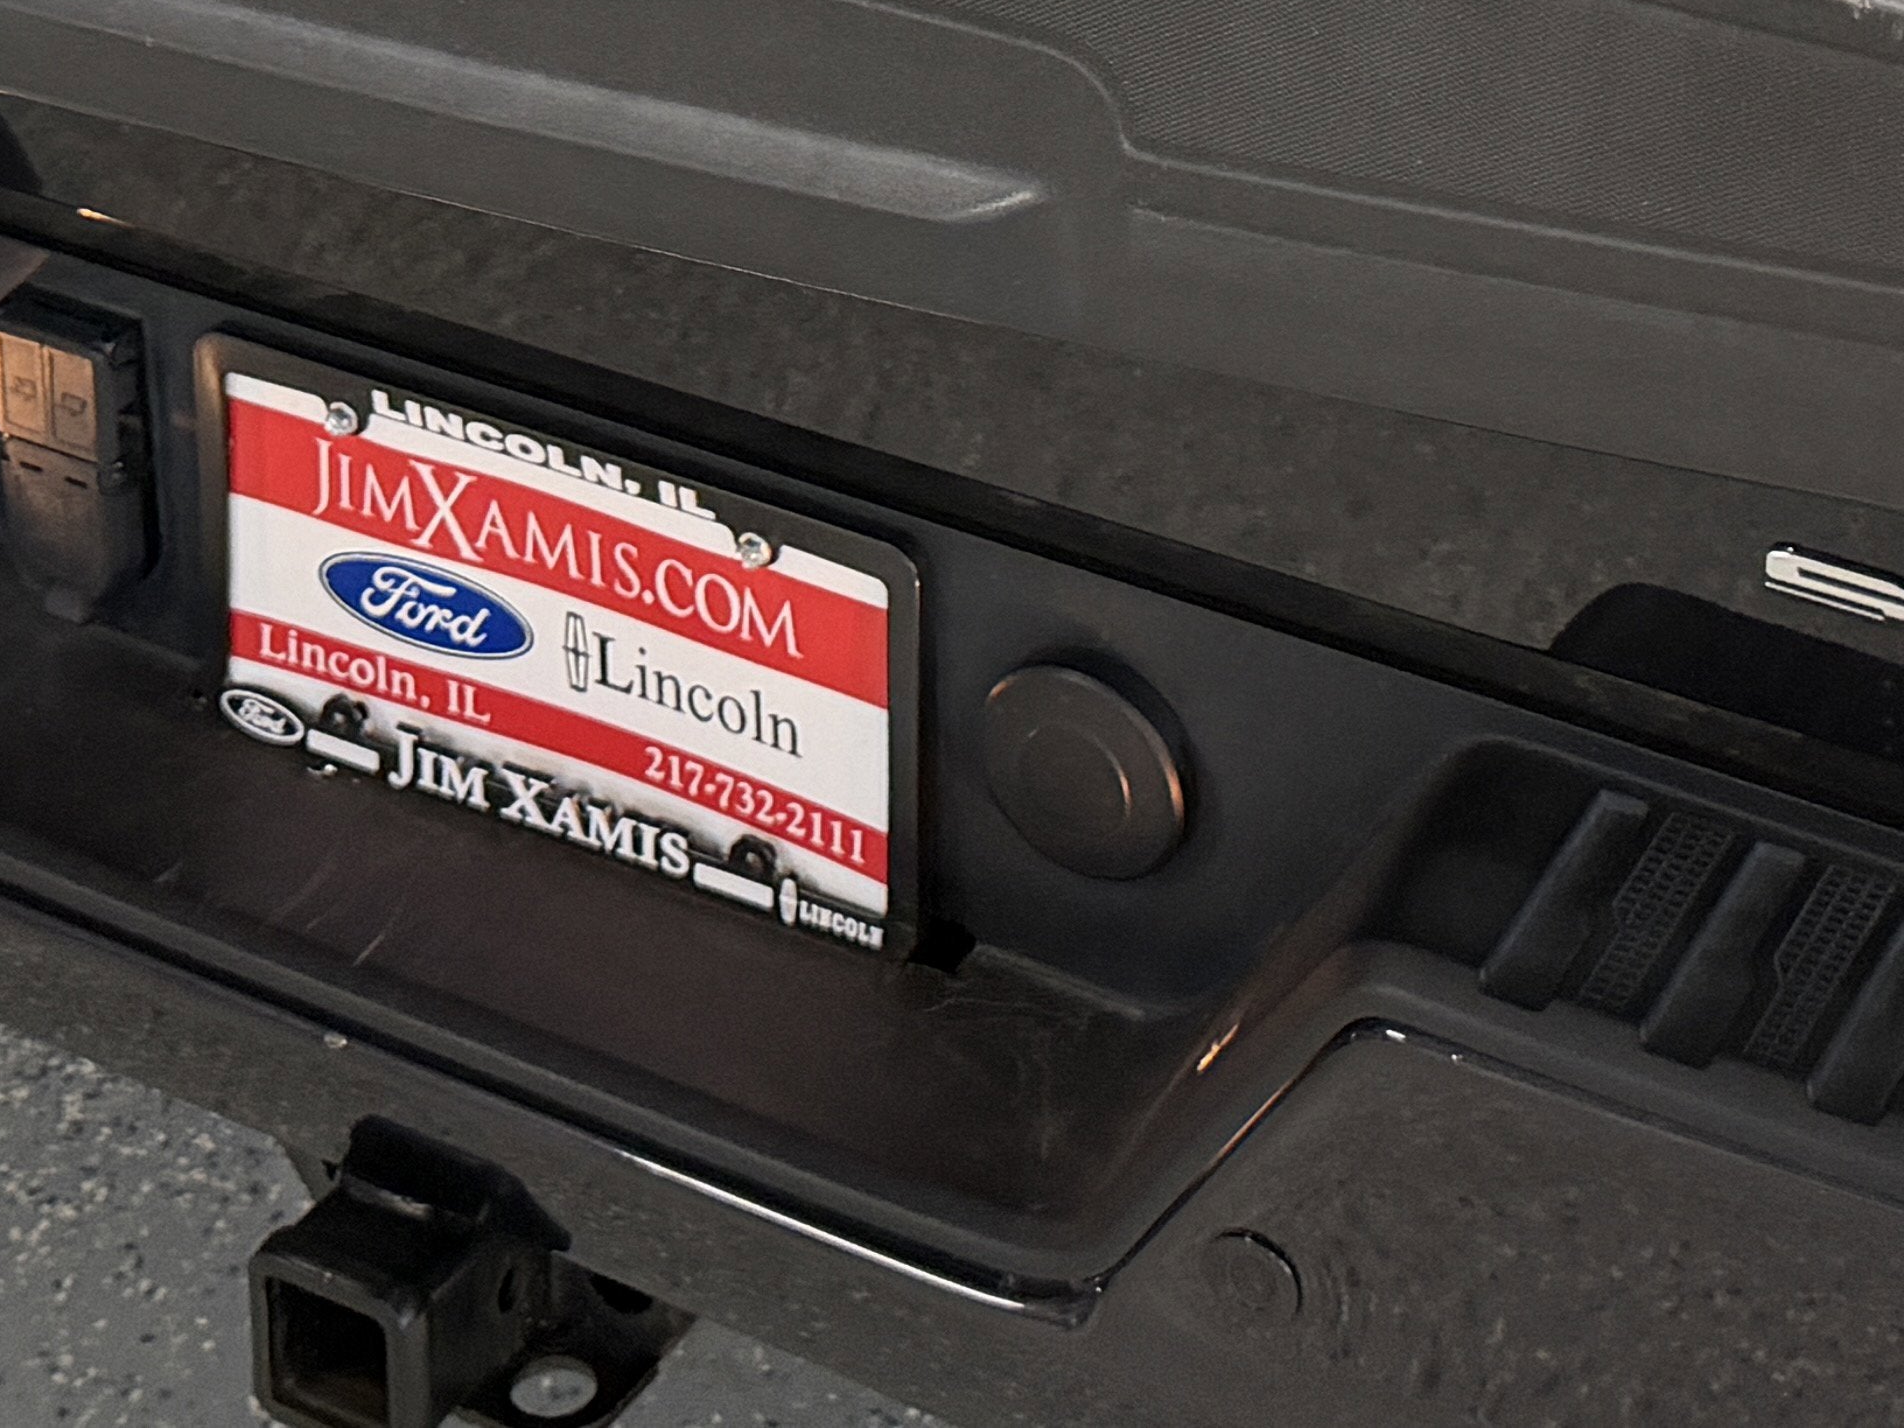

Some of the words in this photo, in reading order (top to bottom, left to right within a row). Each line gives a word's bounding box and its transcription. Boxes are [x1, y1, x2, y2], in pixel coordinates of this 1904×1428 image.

[371, 388, 642, 495] LINCOLN,
[658, 479, 717, 521] IL
[312, 437, 805, 660] JIMXAMIS.COM
[359, 563, 491, 648] Ford
[259, 622, 431, 709] Lincoln,
[446, 679, 492, 724] IL
[595, 632, 804, 759] Lincoln
[387, 727, 491, 813] JIM
[499, 767, 692, 880] XAMIS
[643, 745, 866, 865] 217-732-2111
[799, 899, 885, 952] LINCOLN
